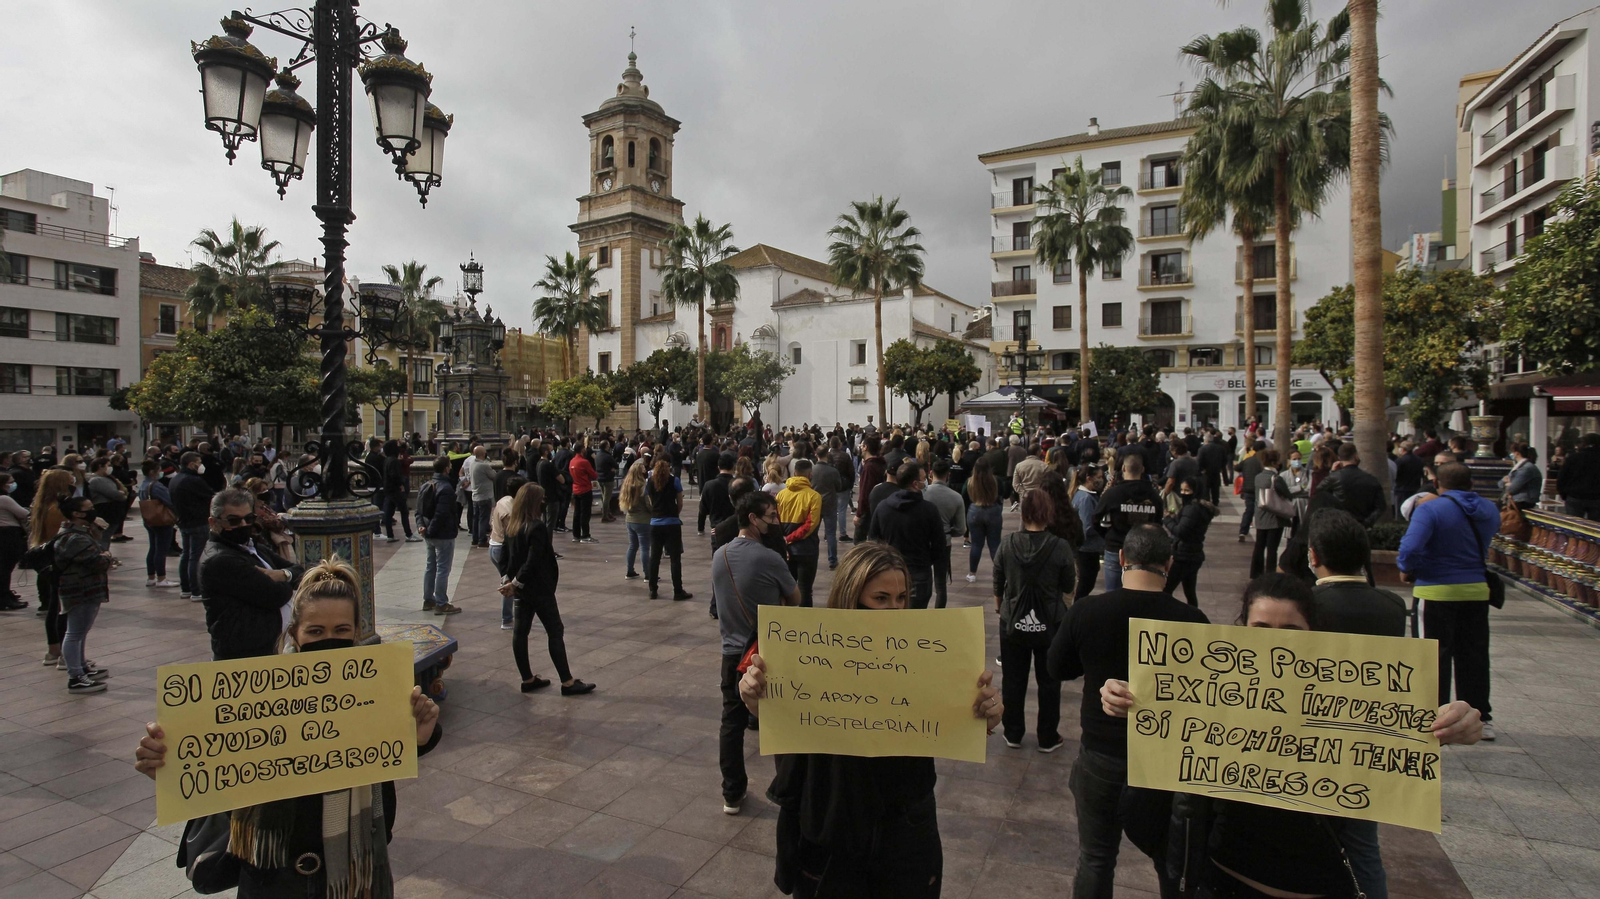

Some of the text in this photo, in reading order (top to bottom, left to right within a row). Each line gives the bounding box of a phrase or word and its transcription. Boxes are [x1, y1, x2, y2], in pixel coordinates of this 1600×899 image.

[1585, 401, 1600, 411] Ba
[1120, 503, 1156, 514] HOKANA
[1014, 622, 1047, 632] adidas
[886, 635, 909, 650] no
[917, 638, 948, 653] es
[798, 655, 833, 669] una
[1138, 630, 1414, 693] NO SE PUEDEN
[163, 658, 378, 707] SI AYUDAS AL
[820, 691, 879, 705] APOYO
[890, 696, 910, 707] LA
[177, 720, 340, 760] AYUDA AL
[1181, 717, 1343, 765] PROHIBEN
[1350, 741, 1439, 781] TENER
[1179, 746, 1370, 809] INGRESOS
